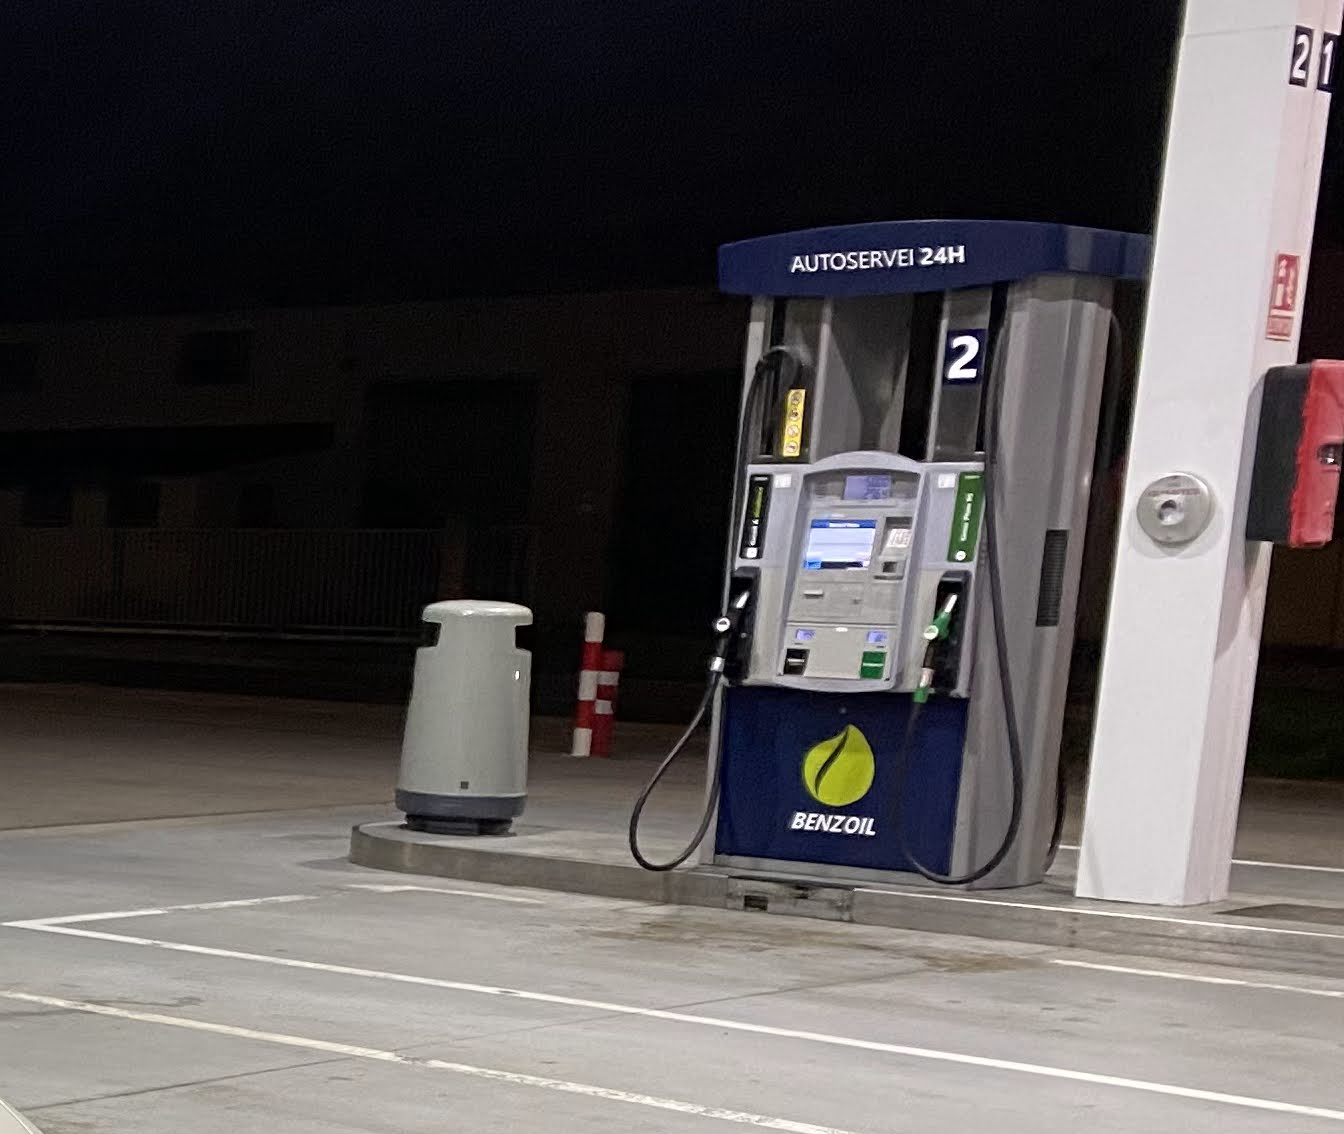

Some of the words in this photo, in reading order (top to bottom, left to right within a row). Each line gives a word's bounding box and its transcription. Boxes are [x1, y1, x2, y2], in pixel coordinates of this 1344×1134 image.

[1292, 33, 1310, 80] 2
[1322, 40, 1334, 85] 1
[790, 249, 915, 274] AUTOSERVEI
[918, 245, 966, 266] 24H
[946, 335, 981, 380] 2
[790, 811, 877, 836] BENZOIL
